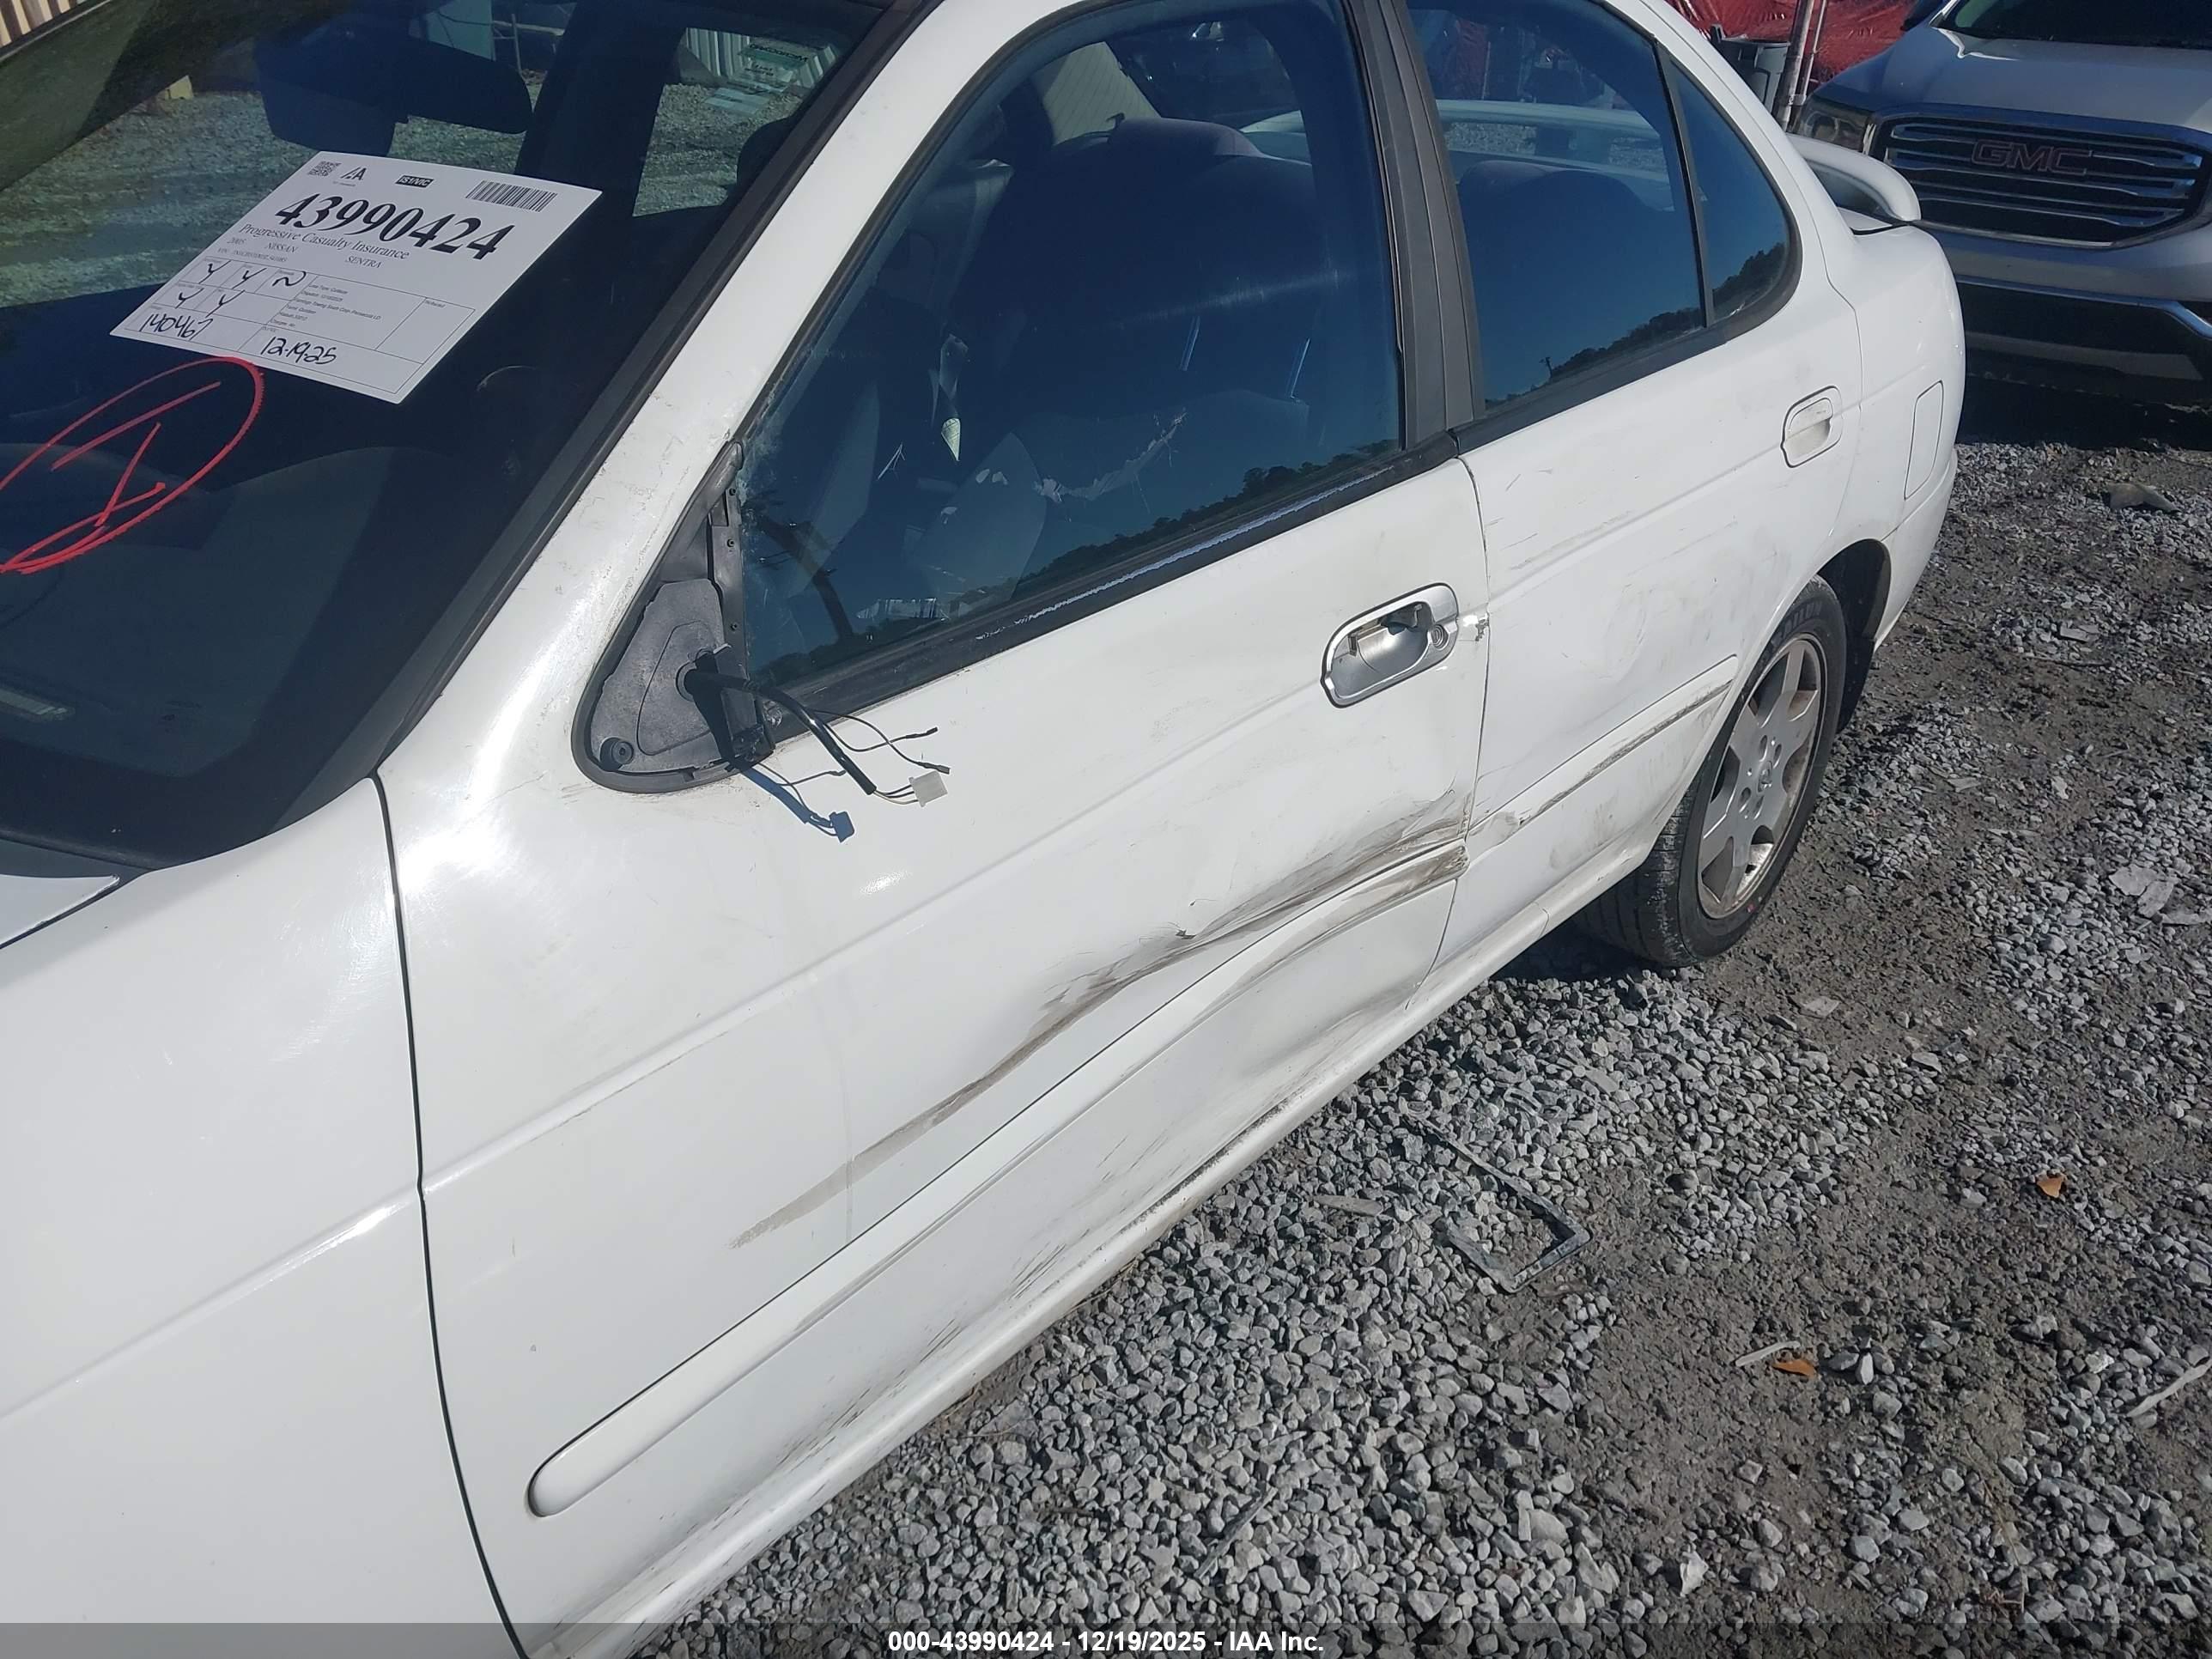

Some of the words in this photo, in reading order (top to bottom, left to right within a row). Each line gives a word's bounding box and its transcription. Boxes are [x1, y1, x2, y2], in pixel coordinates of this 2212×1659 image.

[1972, 138, 2092, 176] GMC
[239, 223, 301, 241] Progressive
[301, 232, 349, 250] Casualty
[351, 240, 410, 259] Insurance
[275, 193, 515, 260] 43990424
[264, 241, 299, 253] NISSAN
[345, 255, 383, 269] SENTRA
[139, 313, 214, 342] 140467
